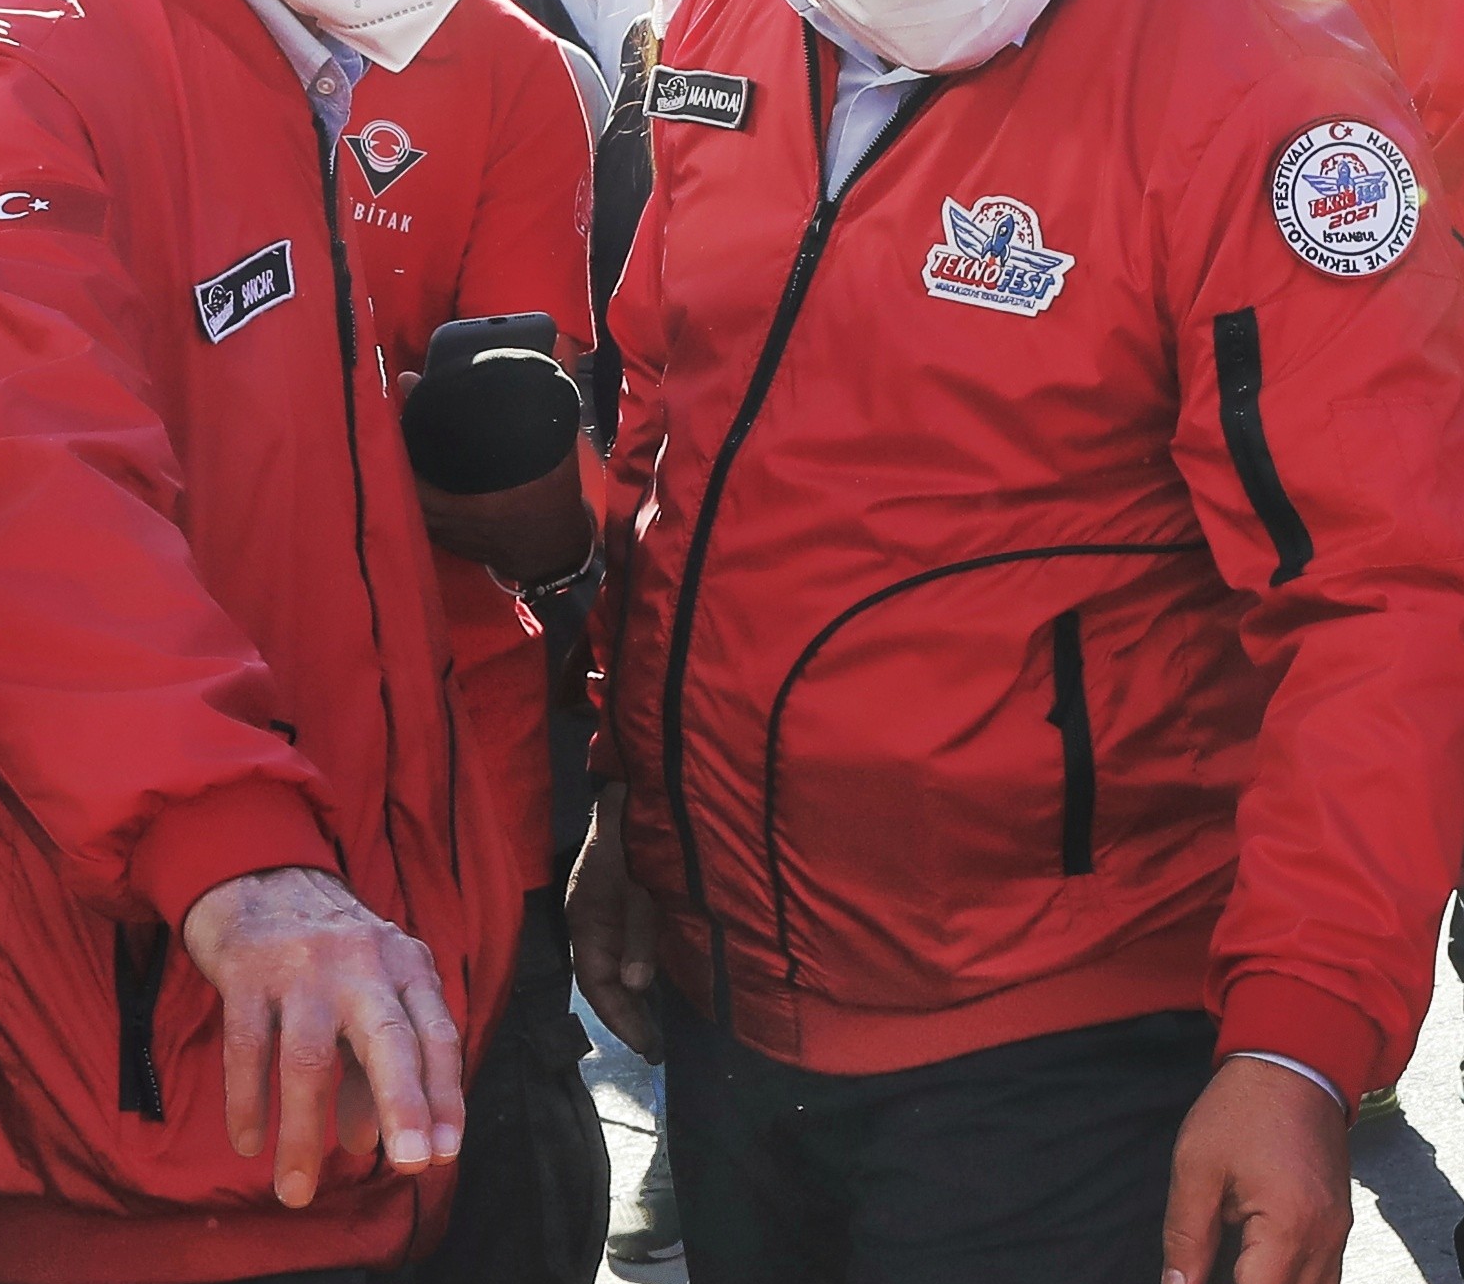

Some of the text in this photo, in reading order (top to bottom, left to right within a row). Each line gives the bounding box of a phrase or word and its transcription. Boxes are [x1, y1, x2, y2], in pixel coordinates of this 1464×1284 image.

[1366, 132, 1417, 212] HAVACILIK
[1328, 203, 1378, 230] 2021
[1388, 214, 1416, 258] UZAY
[930, 251, 1055, 300] TEKNOFEST
[1366, 252, 1388, 271] VE
